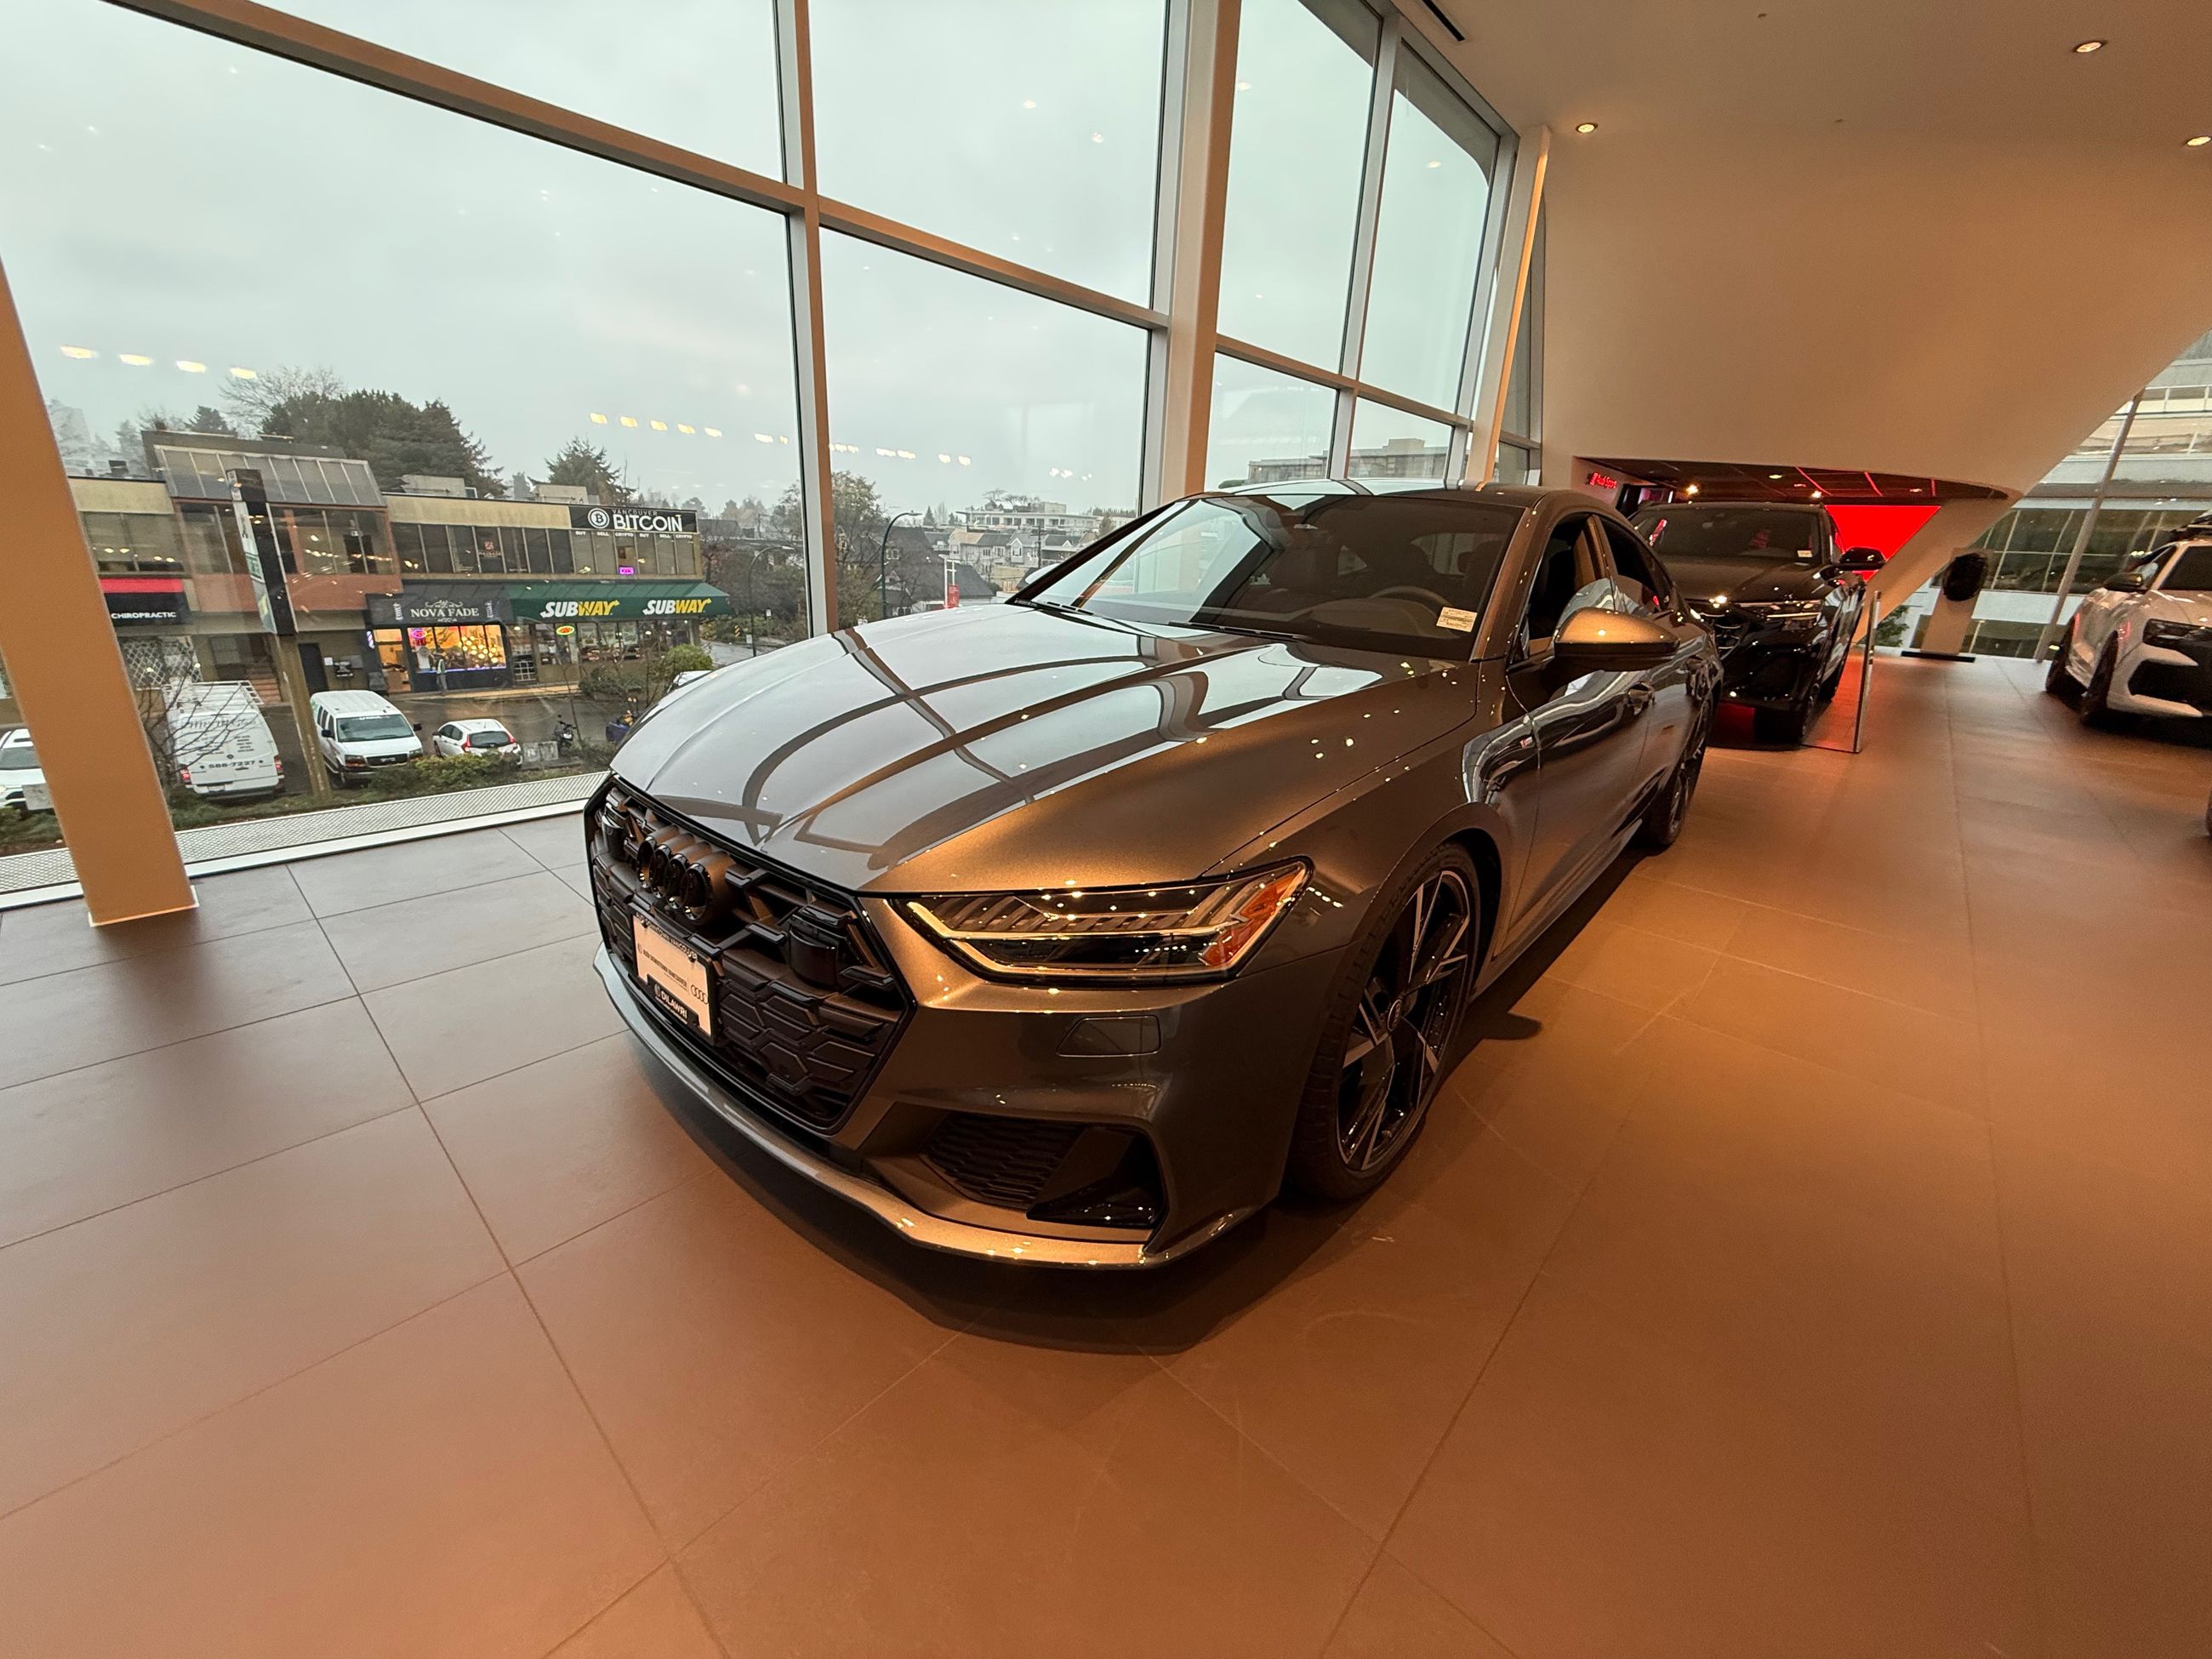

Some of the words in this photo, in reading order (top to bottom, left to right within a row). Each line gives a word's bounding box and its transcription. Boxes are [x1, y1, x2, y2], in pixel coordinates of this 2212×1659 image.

[613, 515, 683, 532] BITCOIN
[410, 608, 445, 619] NOVA
[448, 607, 480, 618] FADE
[540, 600, 620, 619] SUBWAY
[642, 598, 712, 616] SUBWAY
[660, 990, 687, 1019] DILAWRI
